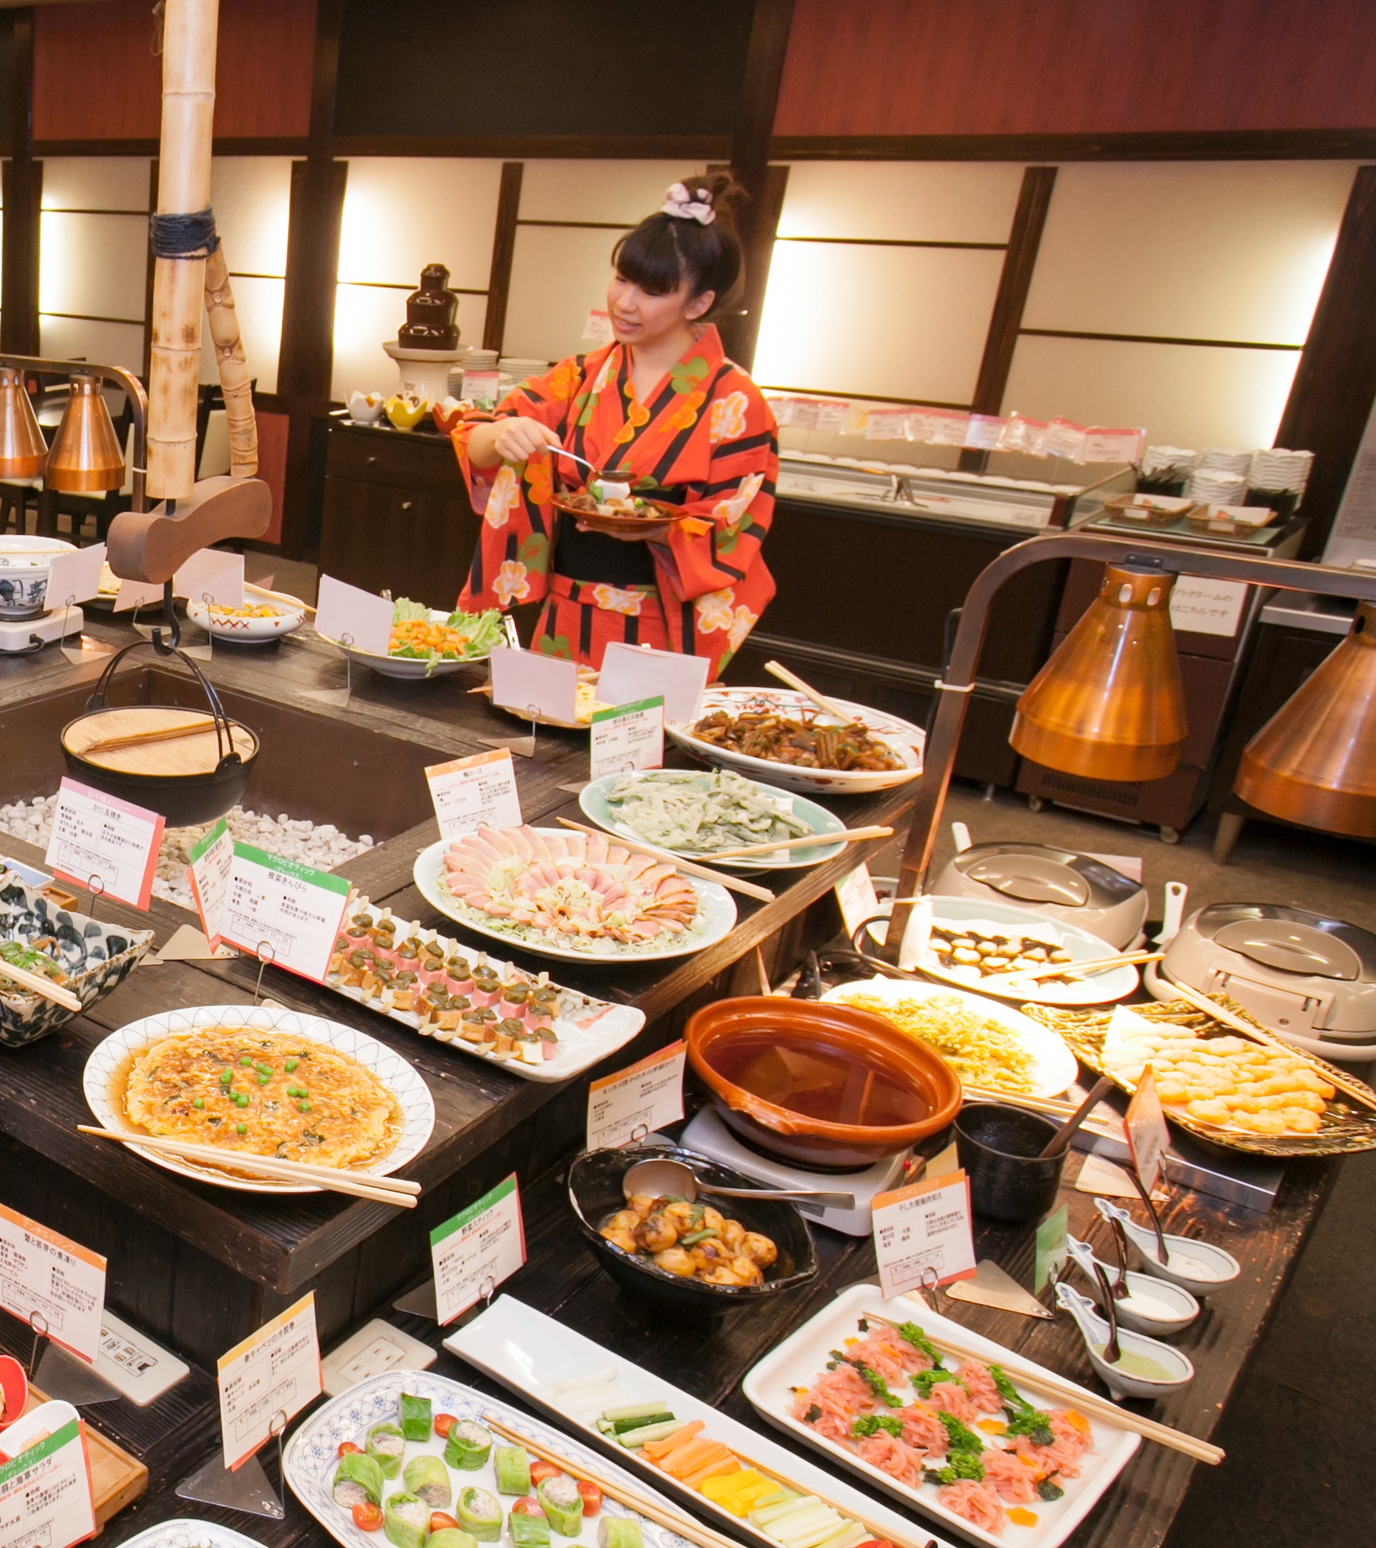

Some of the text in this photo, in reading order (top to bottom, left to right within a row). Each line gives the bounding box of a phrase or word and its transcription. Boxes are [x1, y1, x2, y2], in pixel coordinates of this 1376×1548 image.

[92, 803, 121, 821] かに玉焼き
[266, 853, 315, 877] マクロビオティック
[267, 870, 308, 892] 根菜きんぴら
[461, 1208, 493, 1236] 野菜スティック
[22, 1219, 75, 1254] アンチエイジング
